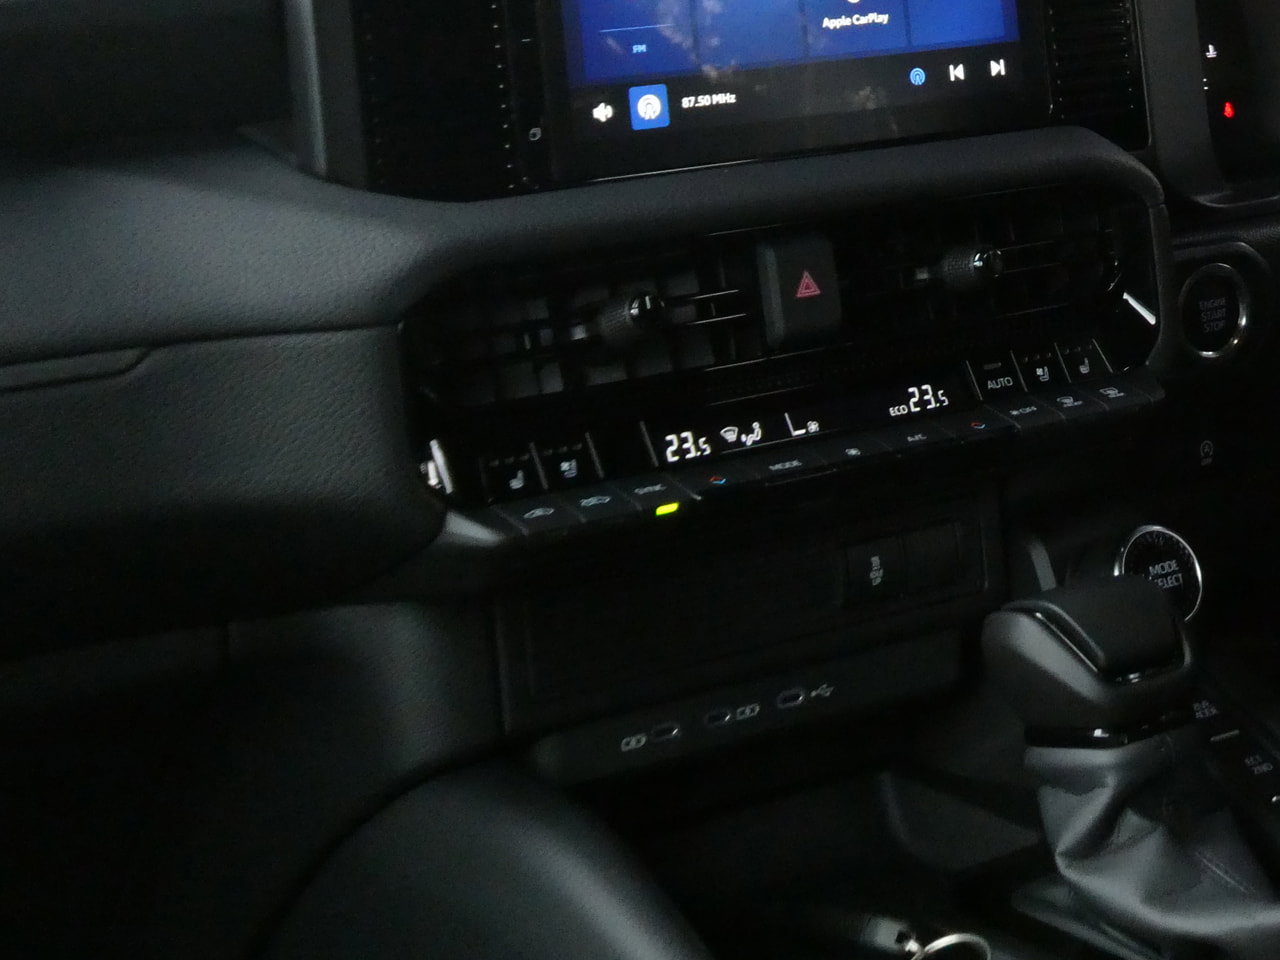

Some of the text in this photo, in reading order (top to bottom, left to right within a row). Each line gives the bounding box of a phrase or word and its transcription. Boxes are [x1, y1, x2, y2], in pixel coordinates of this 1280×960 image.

[822, 12, 889, 30] Apple CarPlay
[632, 44, 647, 53] FM
[681, 92, 736, 109] 87.50 MHz
[1201, 308, 1227, 322] START
[1203, 320, 1226, 333] STOP
[987, 376, 1014, 390] AUTO
[888, 384, 949, 417] ECO 23.5
[664, 431, 712, 463] 23.5
[1148, 560, 1180, 576] MODE
[1149, 572, 1185, 590] ELECT
